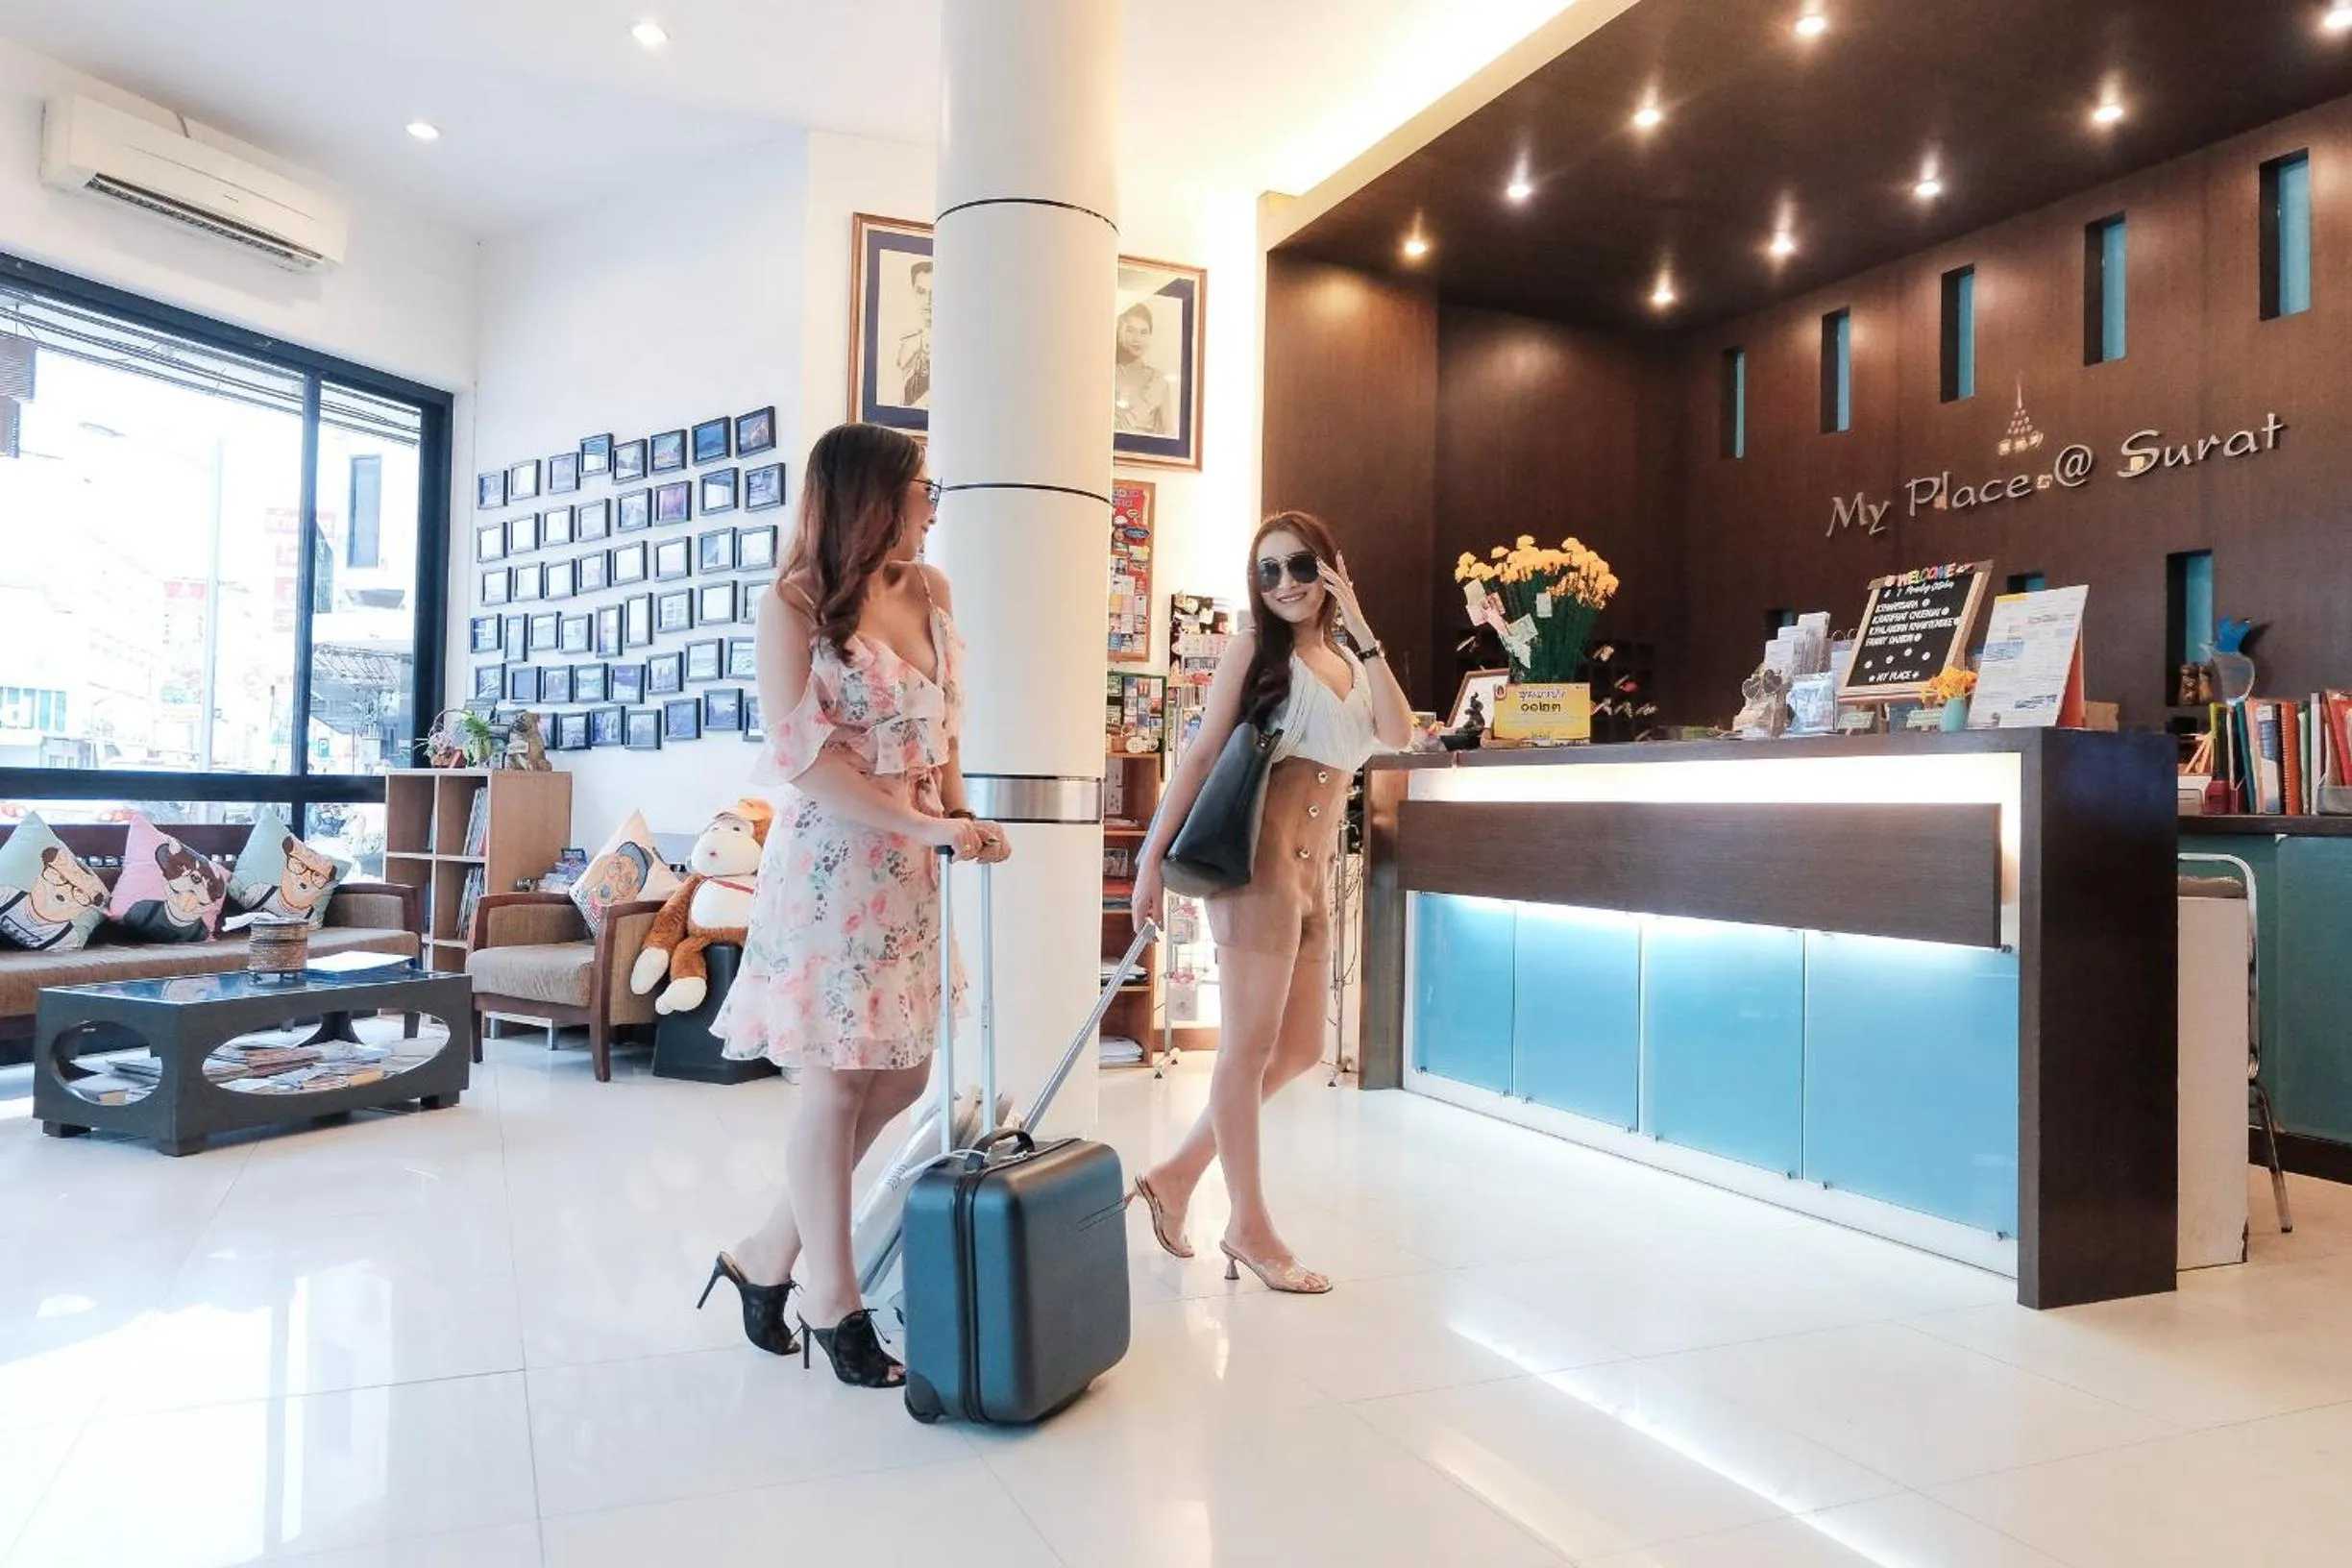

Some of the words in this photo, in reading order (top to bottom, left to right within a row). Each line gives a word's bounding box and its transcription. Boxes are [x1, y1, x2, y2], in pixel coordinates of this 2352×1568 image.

[1825, 492, 1891, 537] My
[1904, 471, 2031, 517] Place
[2054, 445, 2094, 487] @
[2117, 413, 2284, 478] Surat
[1897, 563, 1956, 587] WELCOME
